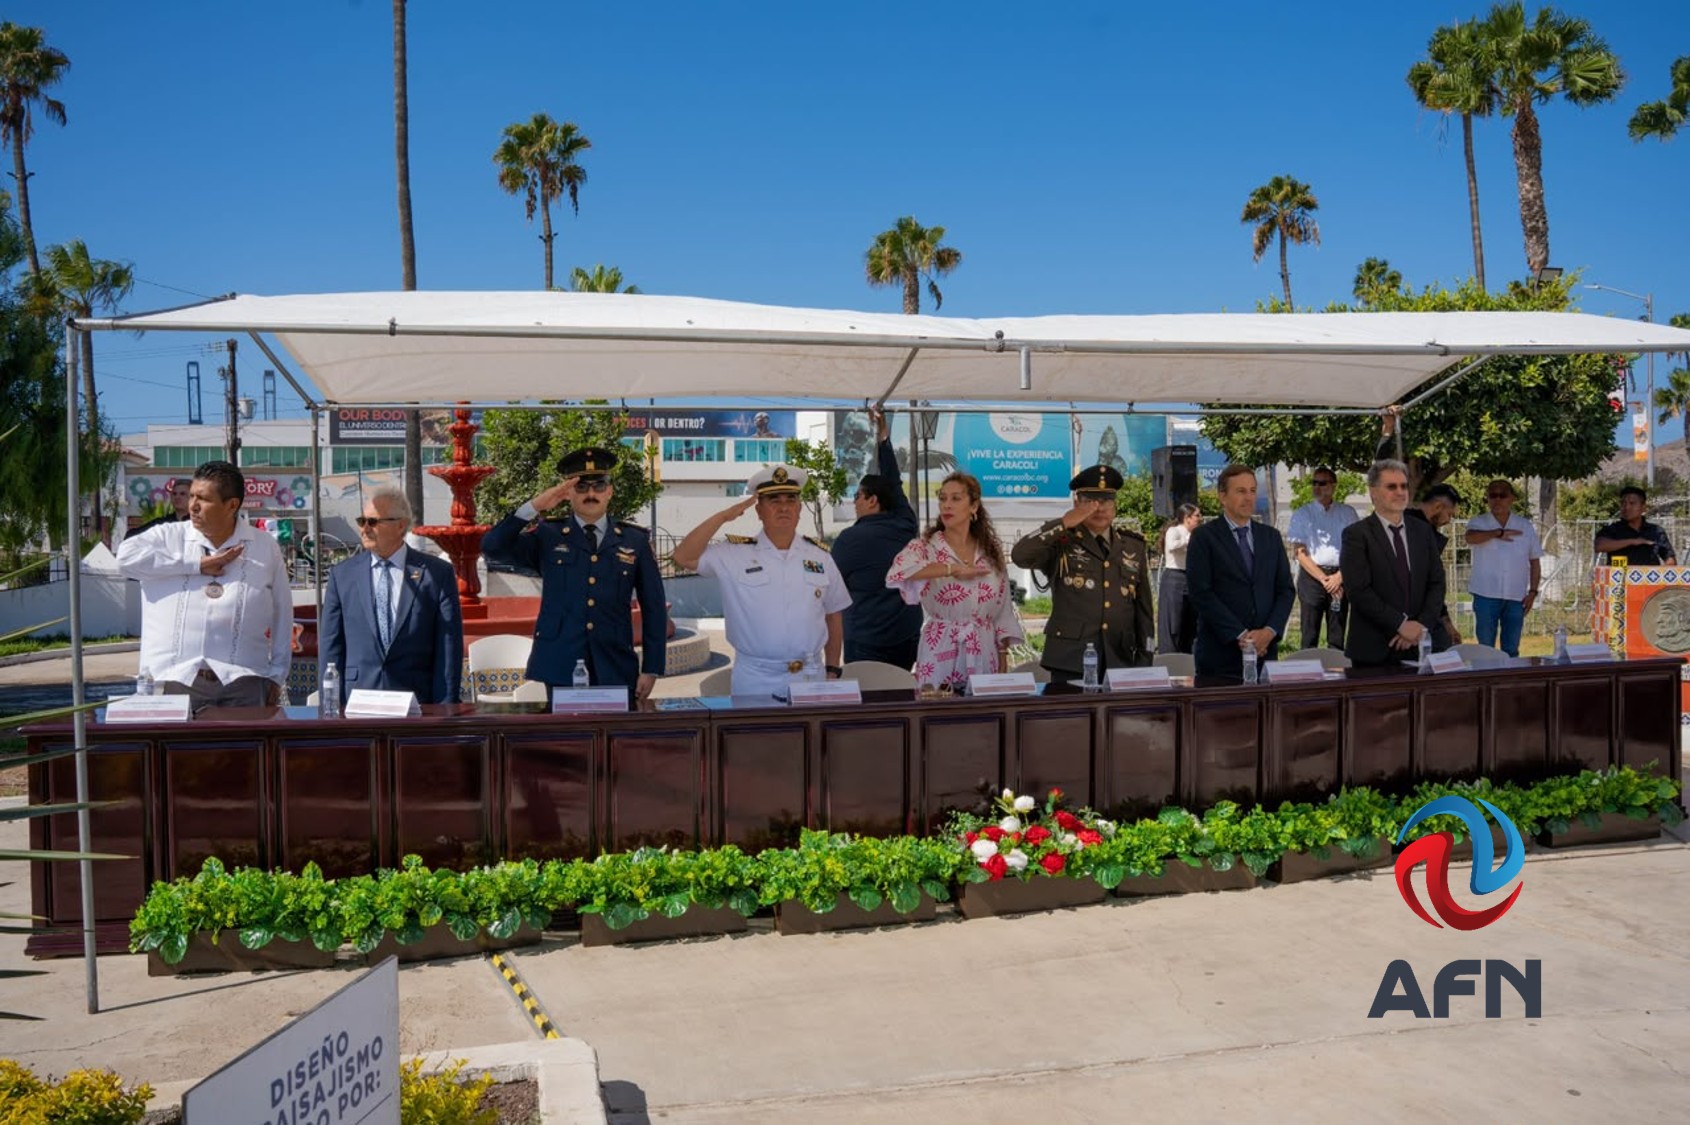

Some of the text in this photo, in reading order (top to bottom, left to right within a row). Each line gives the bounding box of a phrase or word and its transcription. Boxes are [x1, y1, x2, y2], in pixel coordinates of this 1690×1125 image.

[339, 409, 369, 421] OUR
[383, 421, 407, 429] DENTR
[667, 417, 705, 429] DENTRO?
[1001, 425, 1032, 433] CARACOL
[967, 449, 1064, 460] ¡VIVE LA EXPERIENCIA
[992, 460, 1038, 470] CARACOL!
[270, 1030, 349, 1109] DISEÑO
[263, 1035, 383, 1125] AISAJISMO
[338, 1069, 381, 1121] POR:
